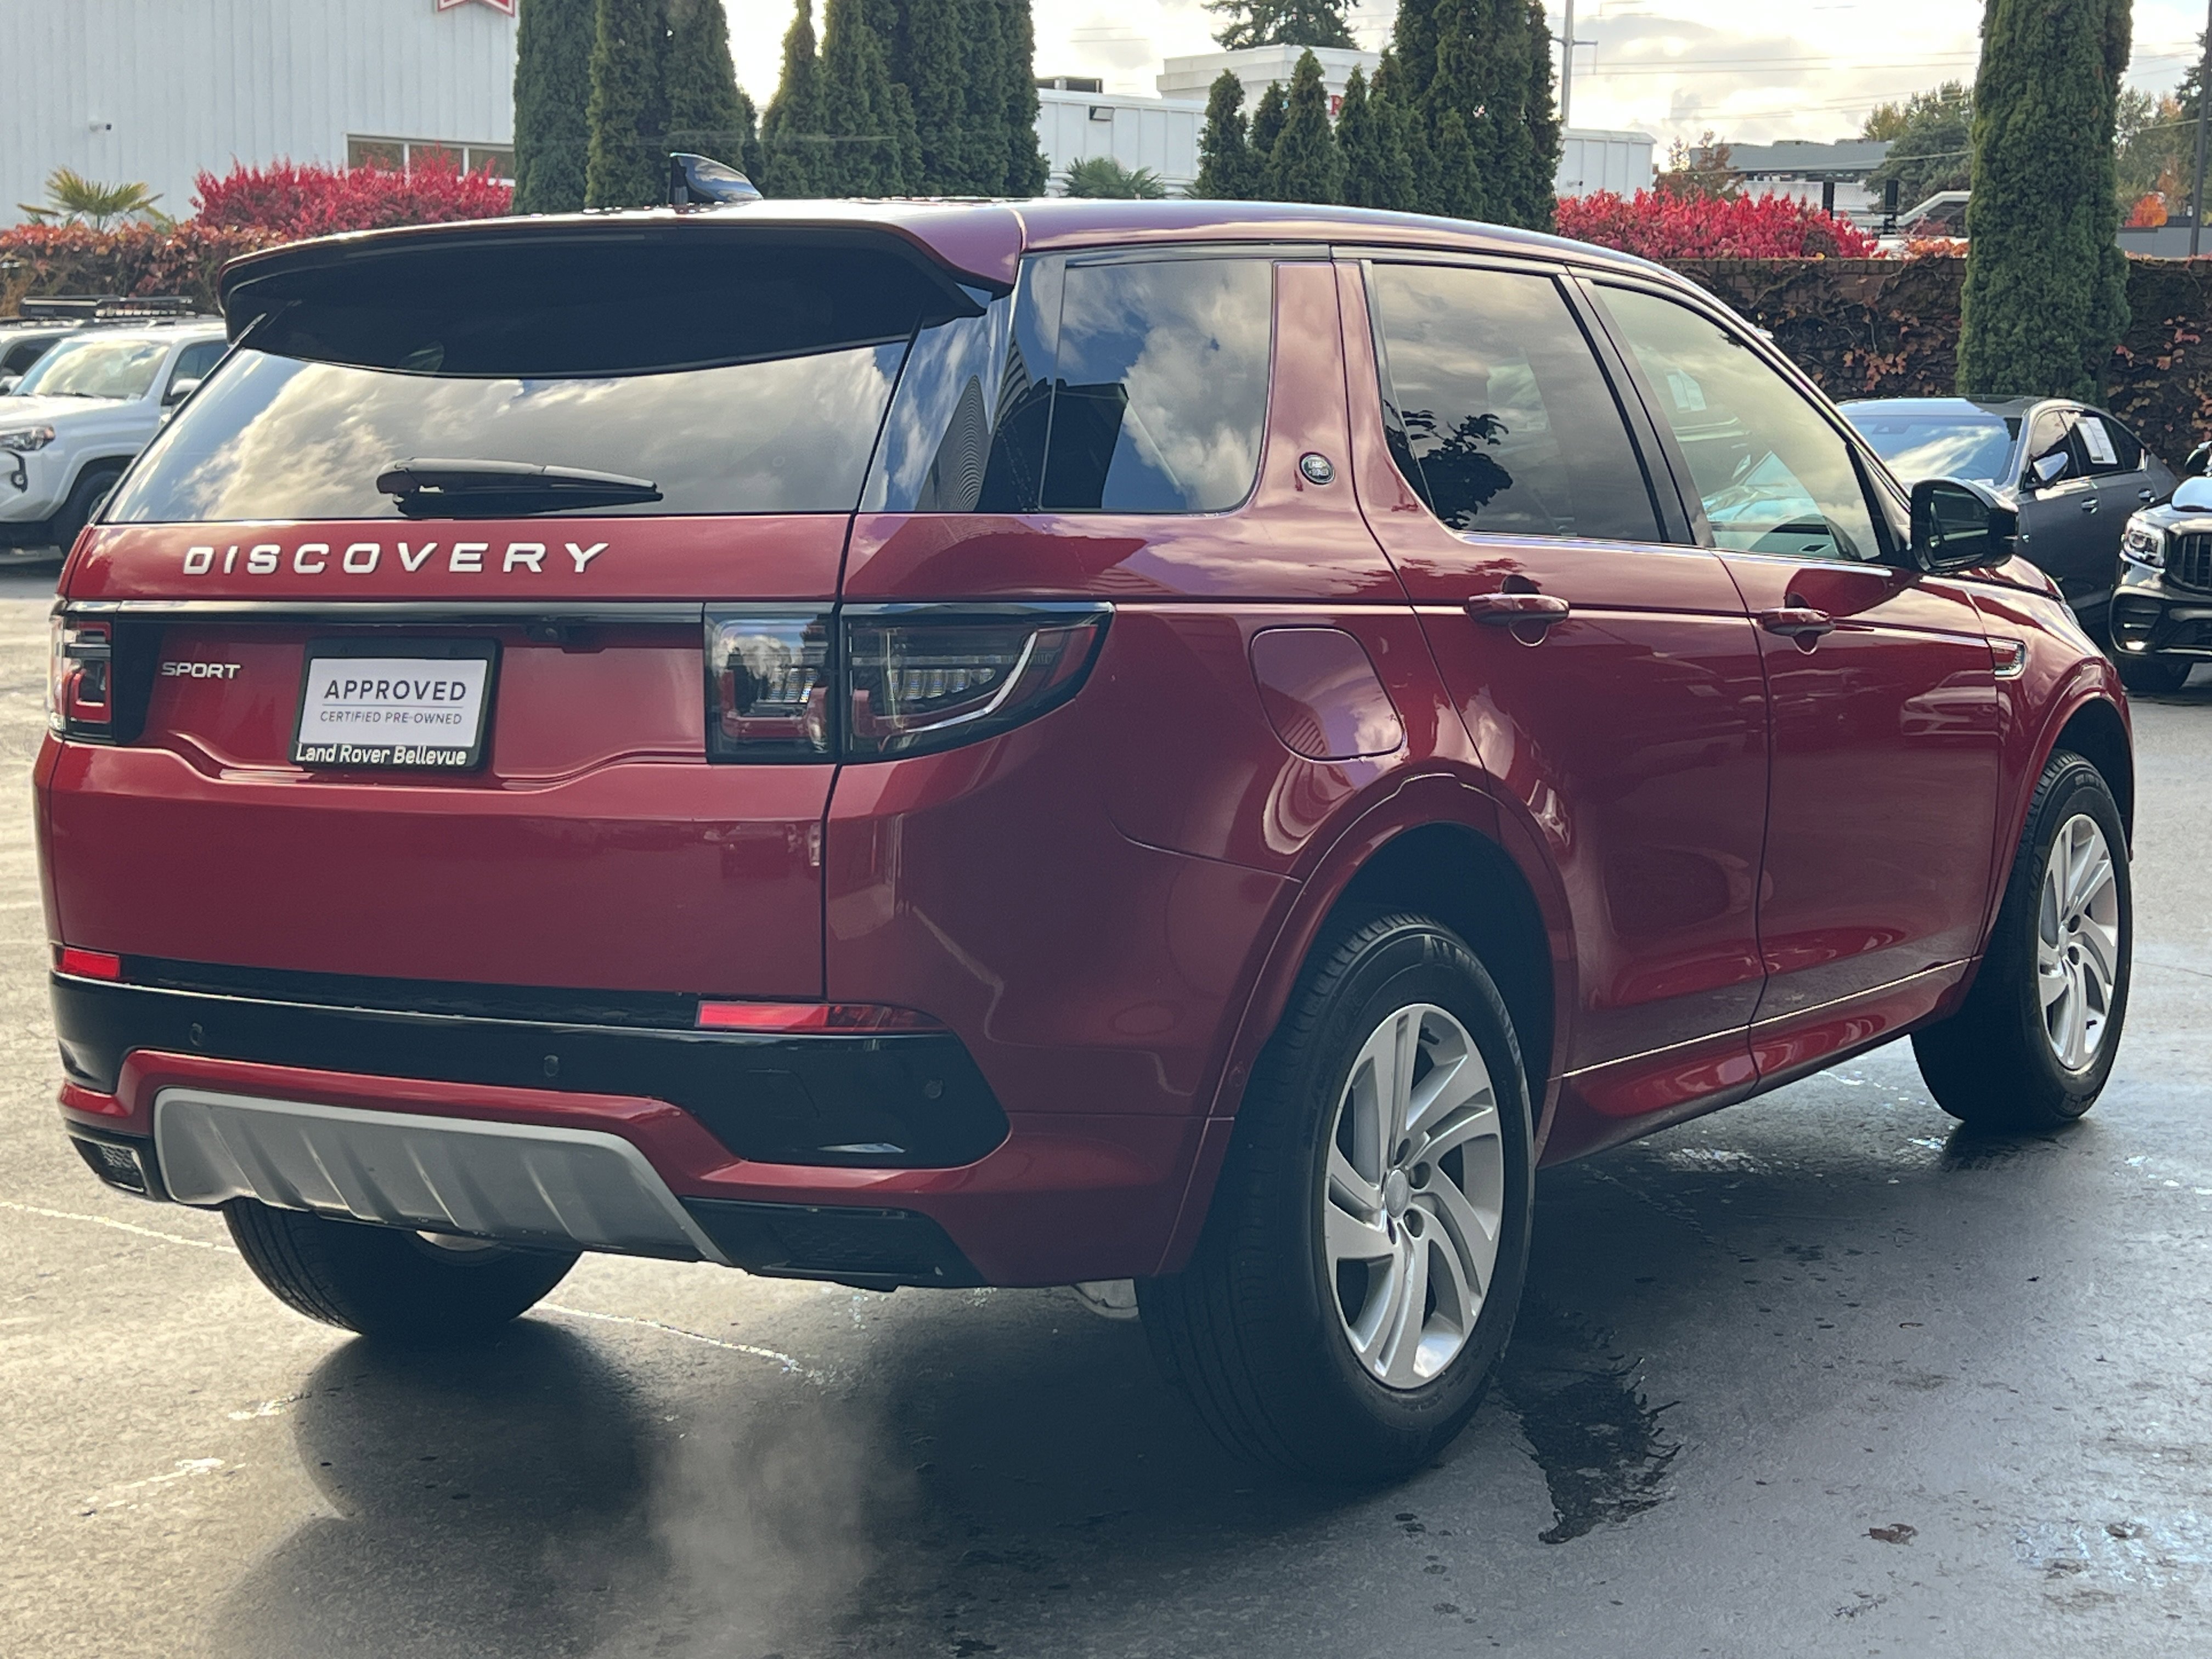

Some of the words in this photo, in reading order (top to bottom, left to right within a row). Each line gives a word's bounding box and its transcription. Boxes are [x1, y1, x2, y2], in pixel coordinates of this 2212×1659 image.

[183, 543, 608, 574] DISCOVERY
[161, 662, 241, 679] SPORT
[324, 680, 466, 701] APPROVED
[320, 712, 381, 723] CERTIFIED
[385, 713, 462, 725] PRE-OWNED
[296, 743, 337, 762] Land
[340, 744, 390, 763] Rover
[393, 746, 467, 765] Bellevue
